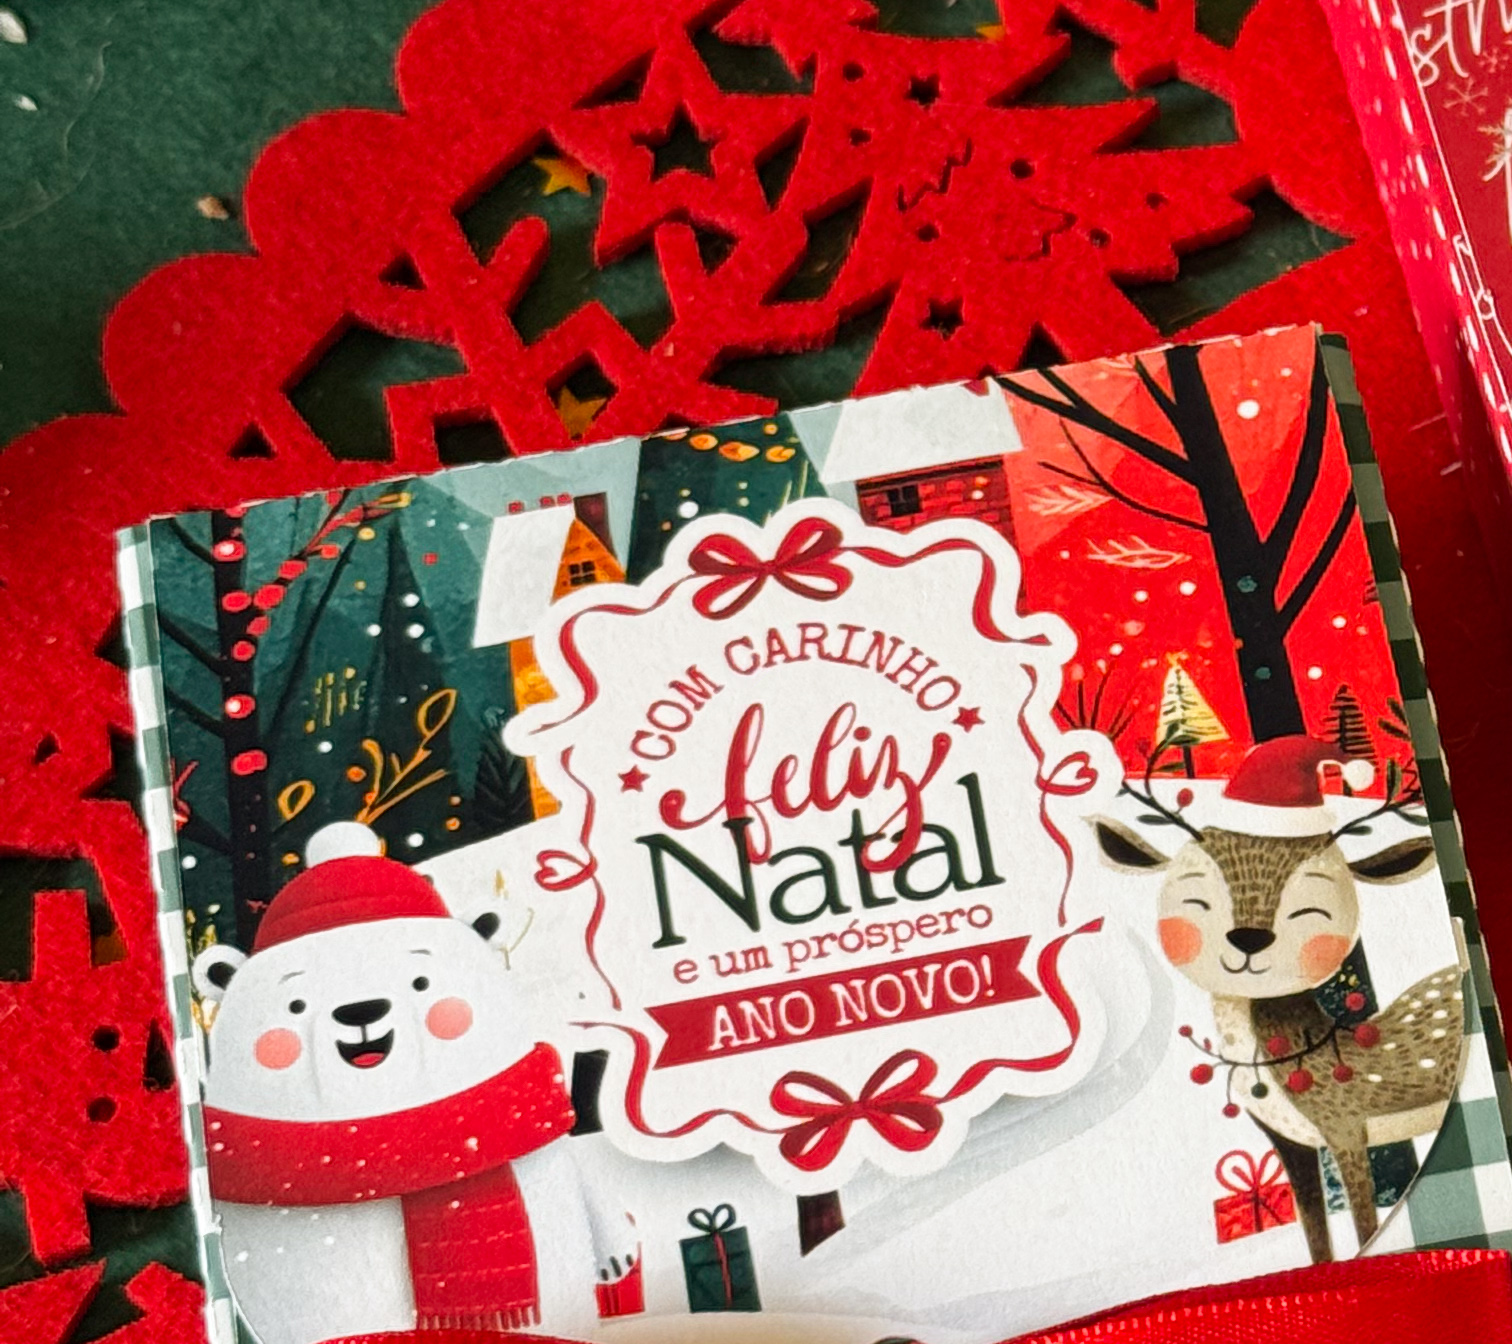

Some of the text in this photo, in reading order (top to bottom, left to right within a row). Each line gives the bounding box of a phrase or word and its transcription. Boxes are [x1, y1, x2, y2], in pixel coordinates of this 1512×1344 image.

[630, 622, 962, 761] COM CARINHO
[659, 701, 953, 873] feliz
[635, 772, 1007, 949] Natal
[672, 903, 994, 985] e um próspero
[707, 954, 996, 1051] ANO NOVO!
